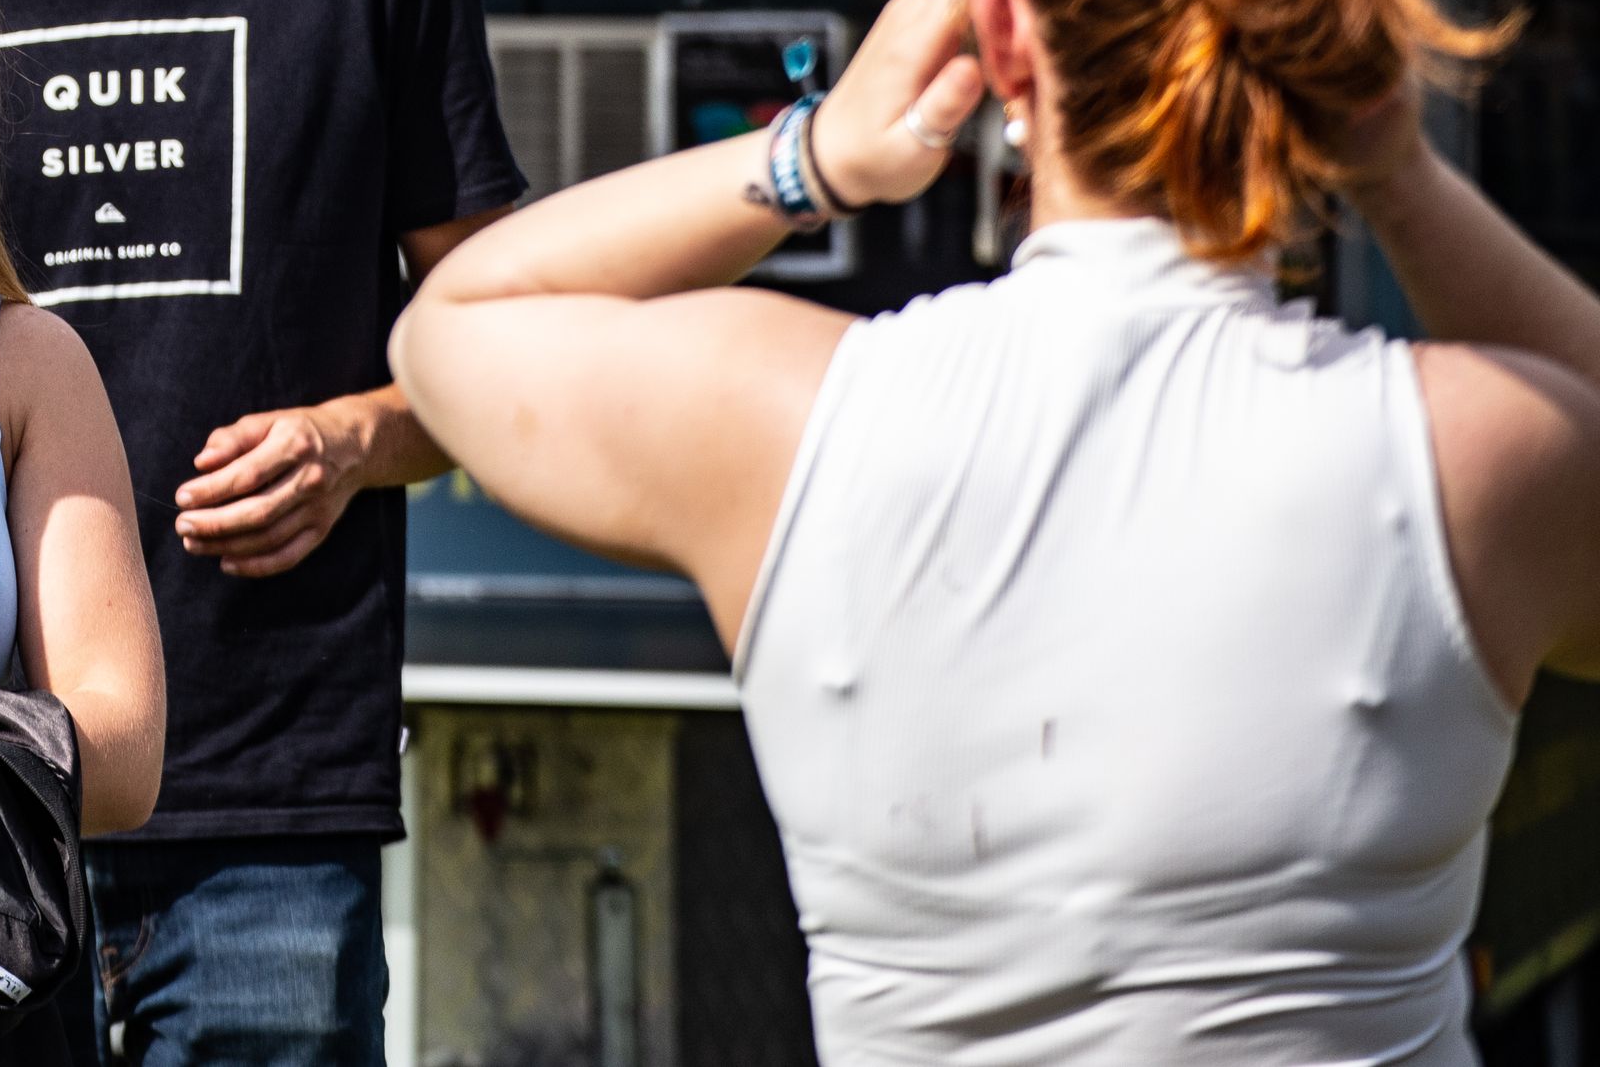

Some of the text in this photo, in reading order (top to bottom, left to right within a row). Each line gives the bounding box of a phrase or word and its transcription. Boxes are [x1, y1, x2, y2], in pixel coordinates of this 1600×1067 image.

[43, 66, 186, 111] QUIK
[41, 139, 184, 178] SILVER
[44, 241, 182, 267] ORIGINAL SURF CO
